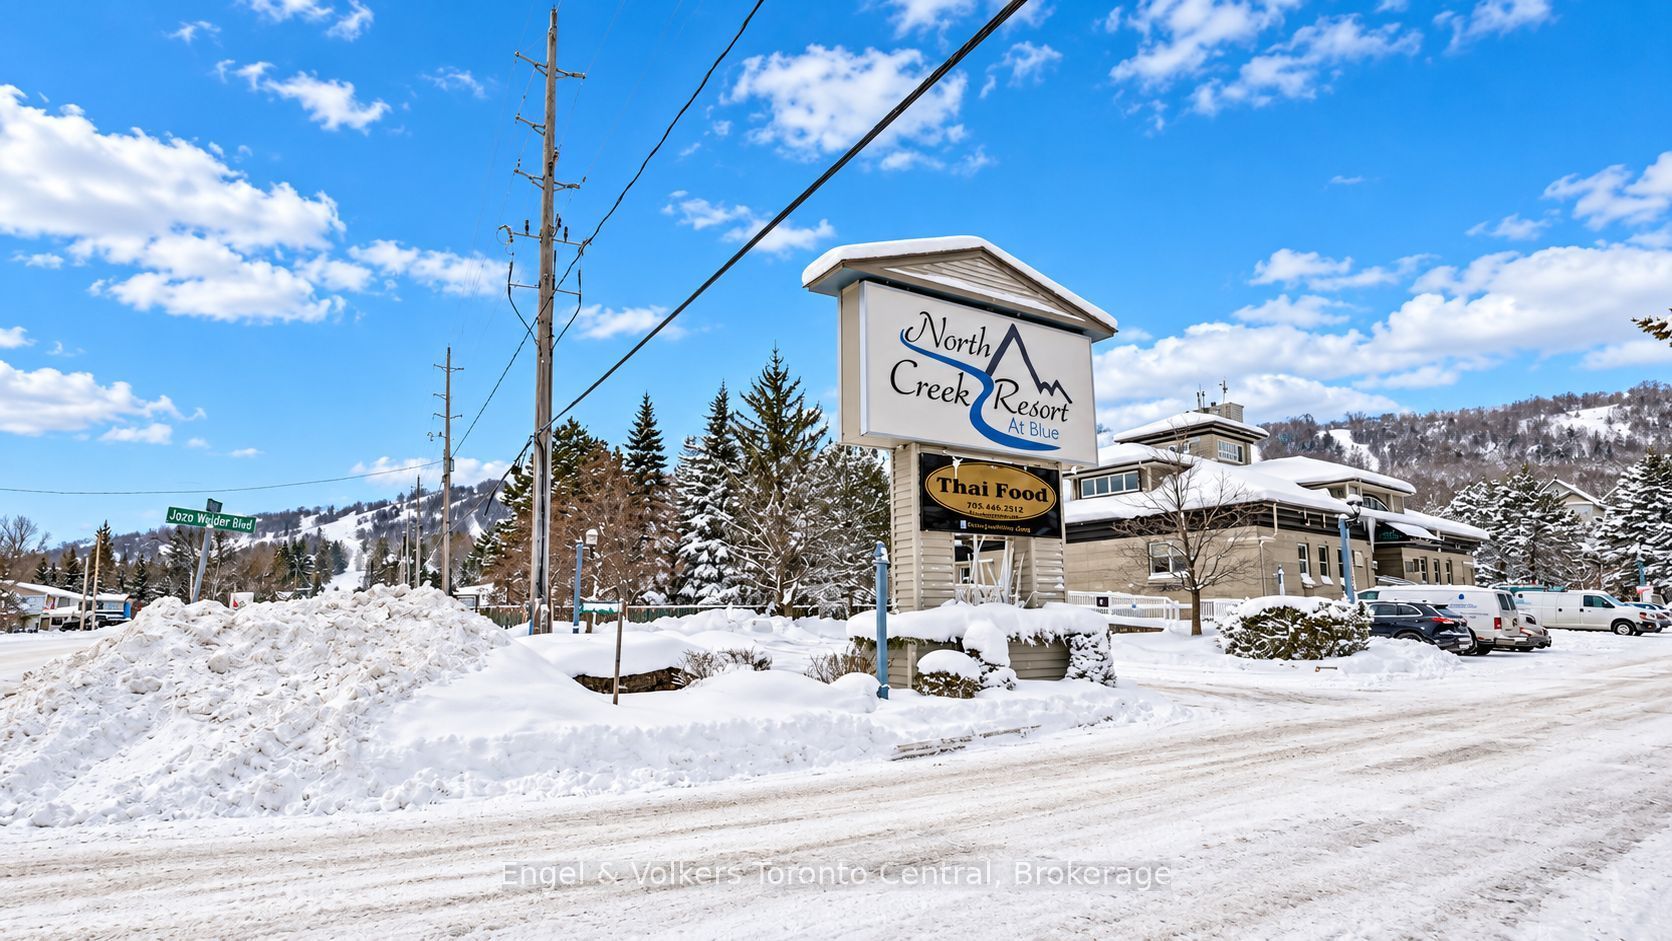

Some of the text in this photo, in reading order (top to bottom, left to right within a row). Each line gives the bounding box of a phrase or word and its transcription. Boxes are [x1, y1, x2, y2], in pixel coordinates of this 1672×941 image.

[904, 311, 991, 357] North
[890, 359, 1069, 422] Creek Resort
[1008, 417, 1059, 440] At Blue
[937, 477, 1049, 503] Thai Food
[169, 509, 194, 523] Jozo
